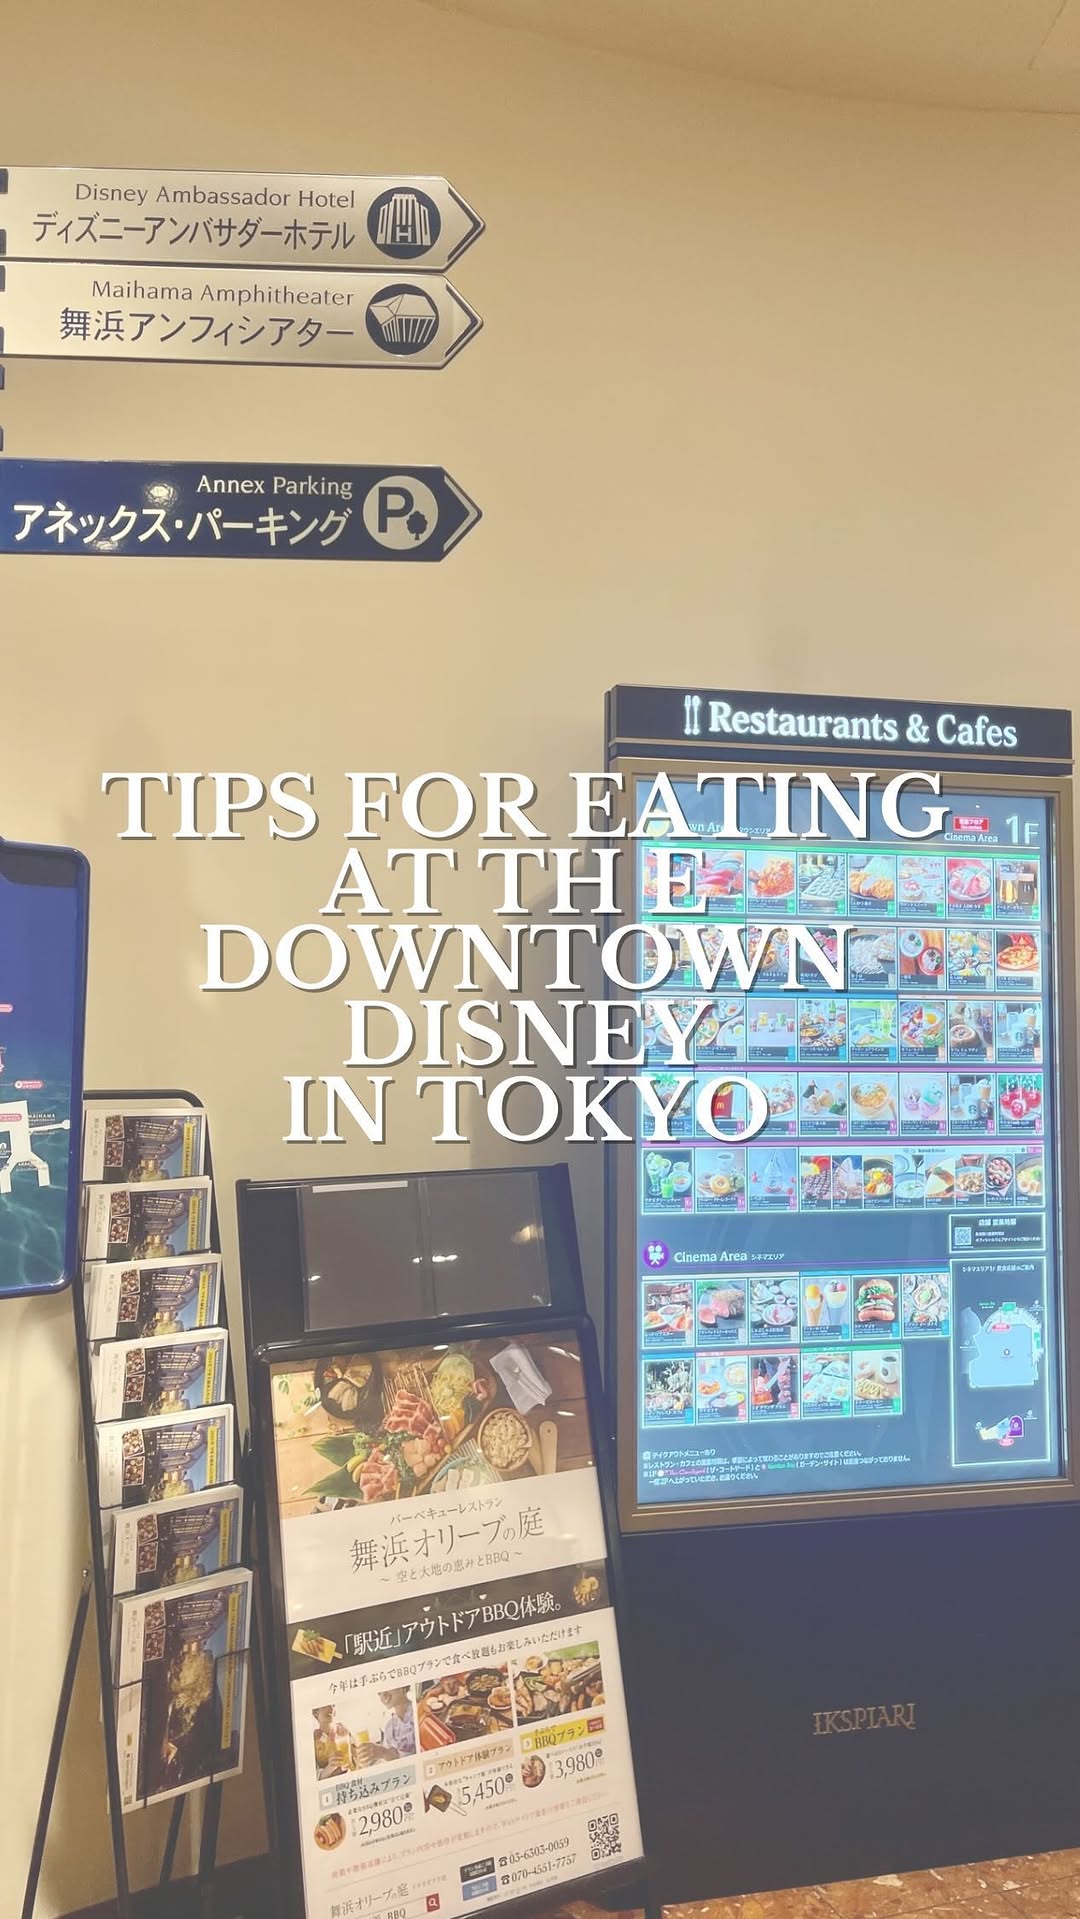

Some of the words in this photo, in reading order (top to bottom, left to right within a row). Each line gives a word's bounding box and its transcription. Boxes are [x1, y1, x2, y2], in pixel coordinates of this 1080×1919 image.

[75, 183, 147, 207] Disney
[156, 186, 291, 208] Ambassador
[298, 190, 355, 209] Hotel
[33, 211, 355, 252] ディズニーアンバサダーホテル
[92, 280, 193, 301] Maihama
[200, 284, 354, 306] Amphitheater
[60, 307, 354, 347] 舞浜アンフィシアター
[197, 475, 265, 495] Annex
[272, 476, 353, 499] Parking
[13, 501, 353, 547] アネックス・パーキング
[377, 486, 413, 533] P
[709, 701, 900, 742] Restaurants
[906, 714, 930, 744] &
[937, 715, 1018, 748] Cafes
[944, 832, 976, 842] Cinema
[978, 834, 998, 843] Area
[674, 1251, 717, 1263] Cinema
[719, 1250, 748, 1262] Area
[390, 1498, 503, 1525] バーベキューレストラン
[349, 1506, 545, 1574] 舞浜オリーブの庭
[343, 1592, 561, 1656] 「駅近」アウトドアBBQ体験。
[329, 1625, 583, 1695] 今年は手ぶらでBBQプランで食べ放題もお楽しみいただけます
[812, 1702, 917, 1736] IKSPIARI
[535, 1726, 585, 1749] BBQプラン
[438, 1744, 512, 1771] アウトドア体験プラン
[555, 1751, 595, 1779] 3,980
[336, 1774, 411, 1806] 持ち込みプラン
[462, 1776, 505, 1806] 5,450
[359, 1806, 403, 1837] 2,980
